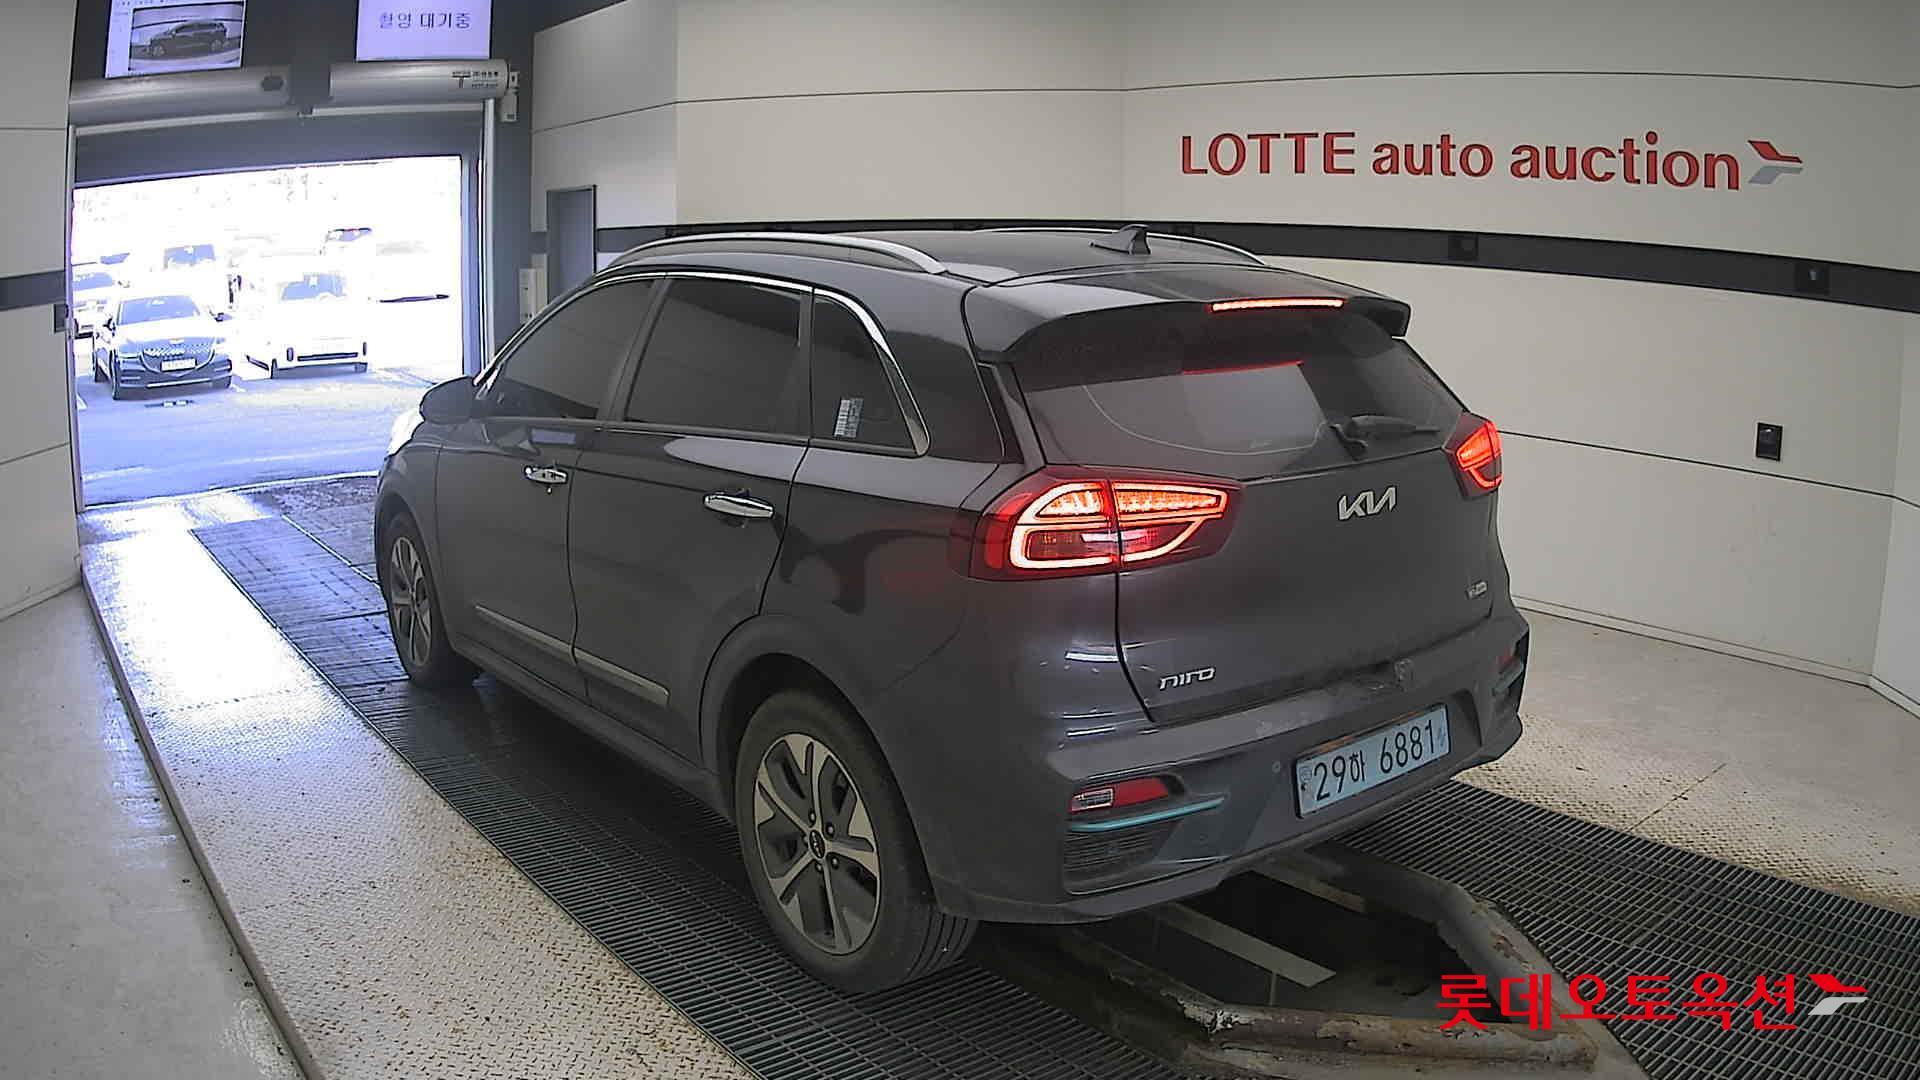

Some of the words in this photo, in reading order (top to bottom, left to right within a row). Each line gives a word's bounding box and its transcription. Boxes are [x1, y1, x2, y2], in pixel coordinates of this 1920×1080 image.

[420, 11, 473, 30] 대기중
[1182, 132, 1356, 176] LOTTE
[1373, 133, 1494, 177] auto
[1510, 131, 1740, 190] auction
[1313, 750, 1366, 801] 29하
[1379, 719, 1435, 774] 6881
